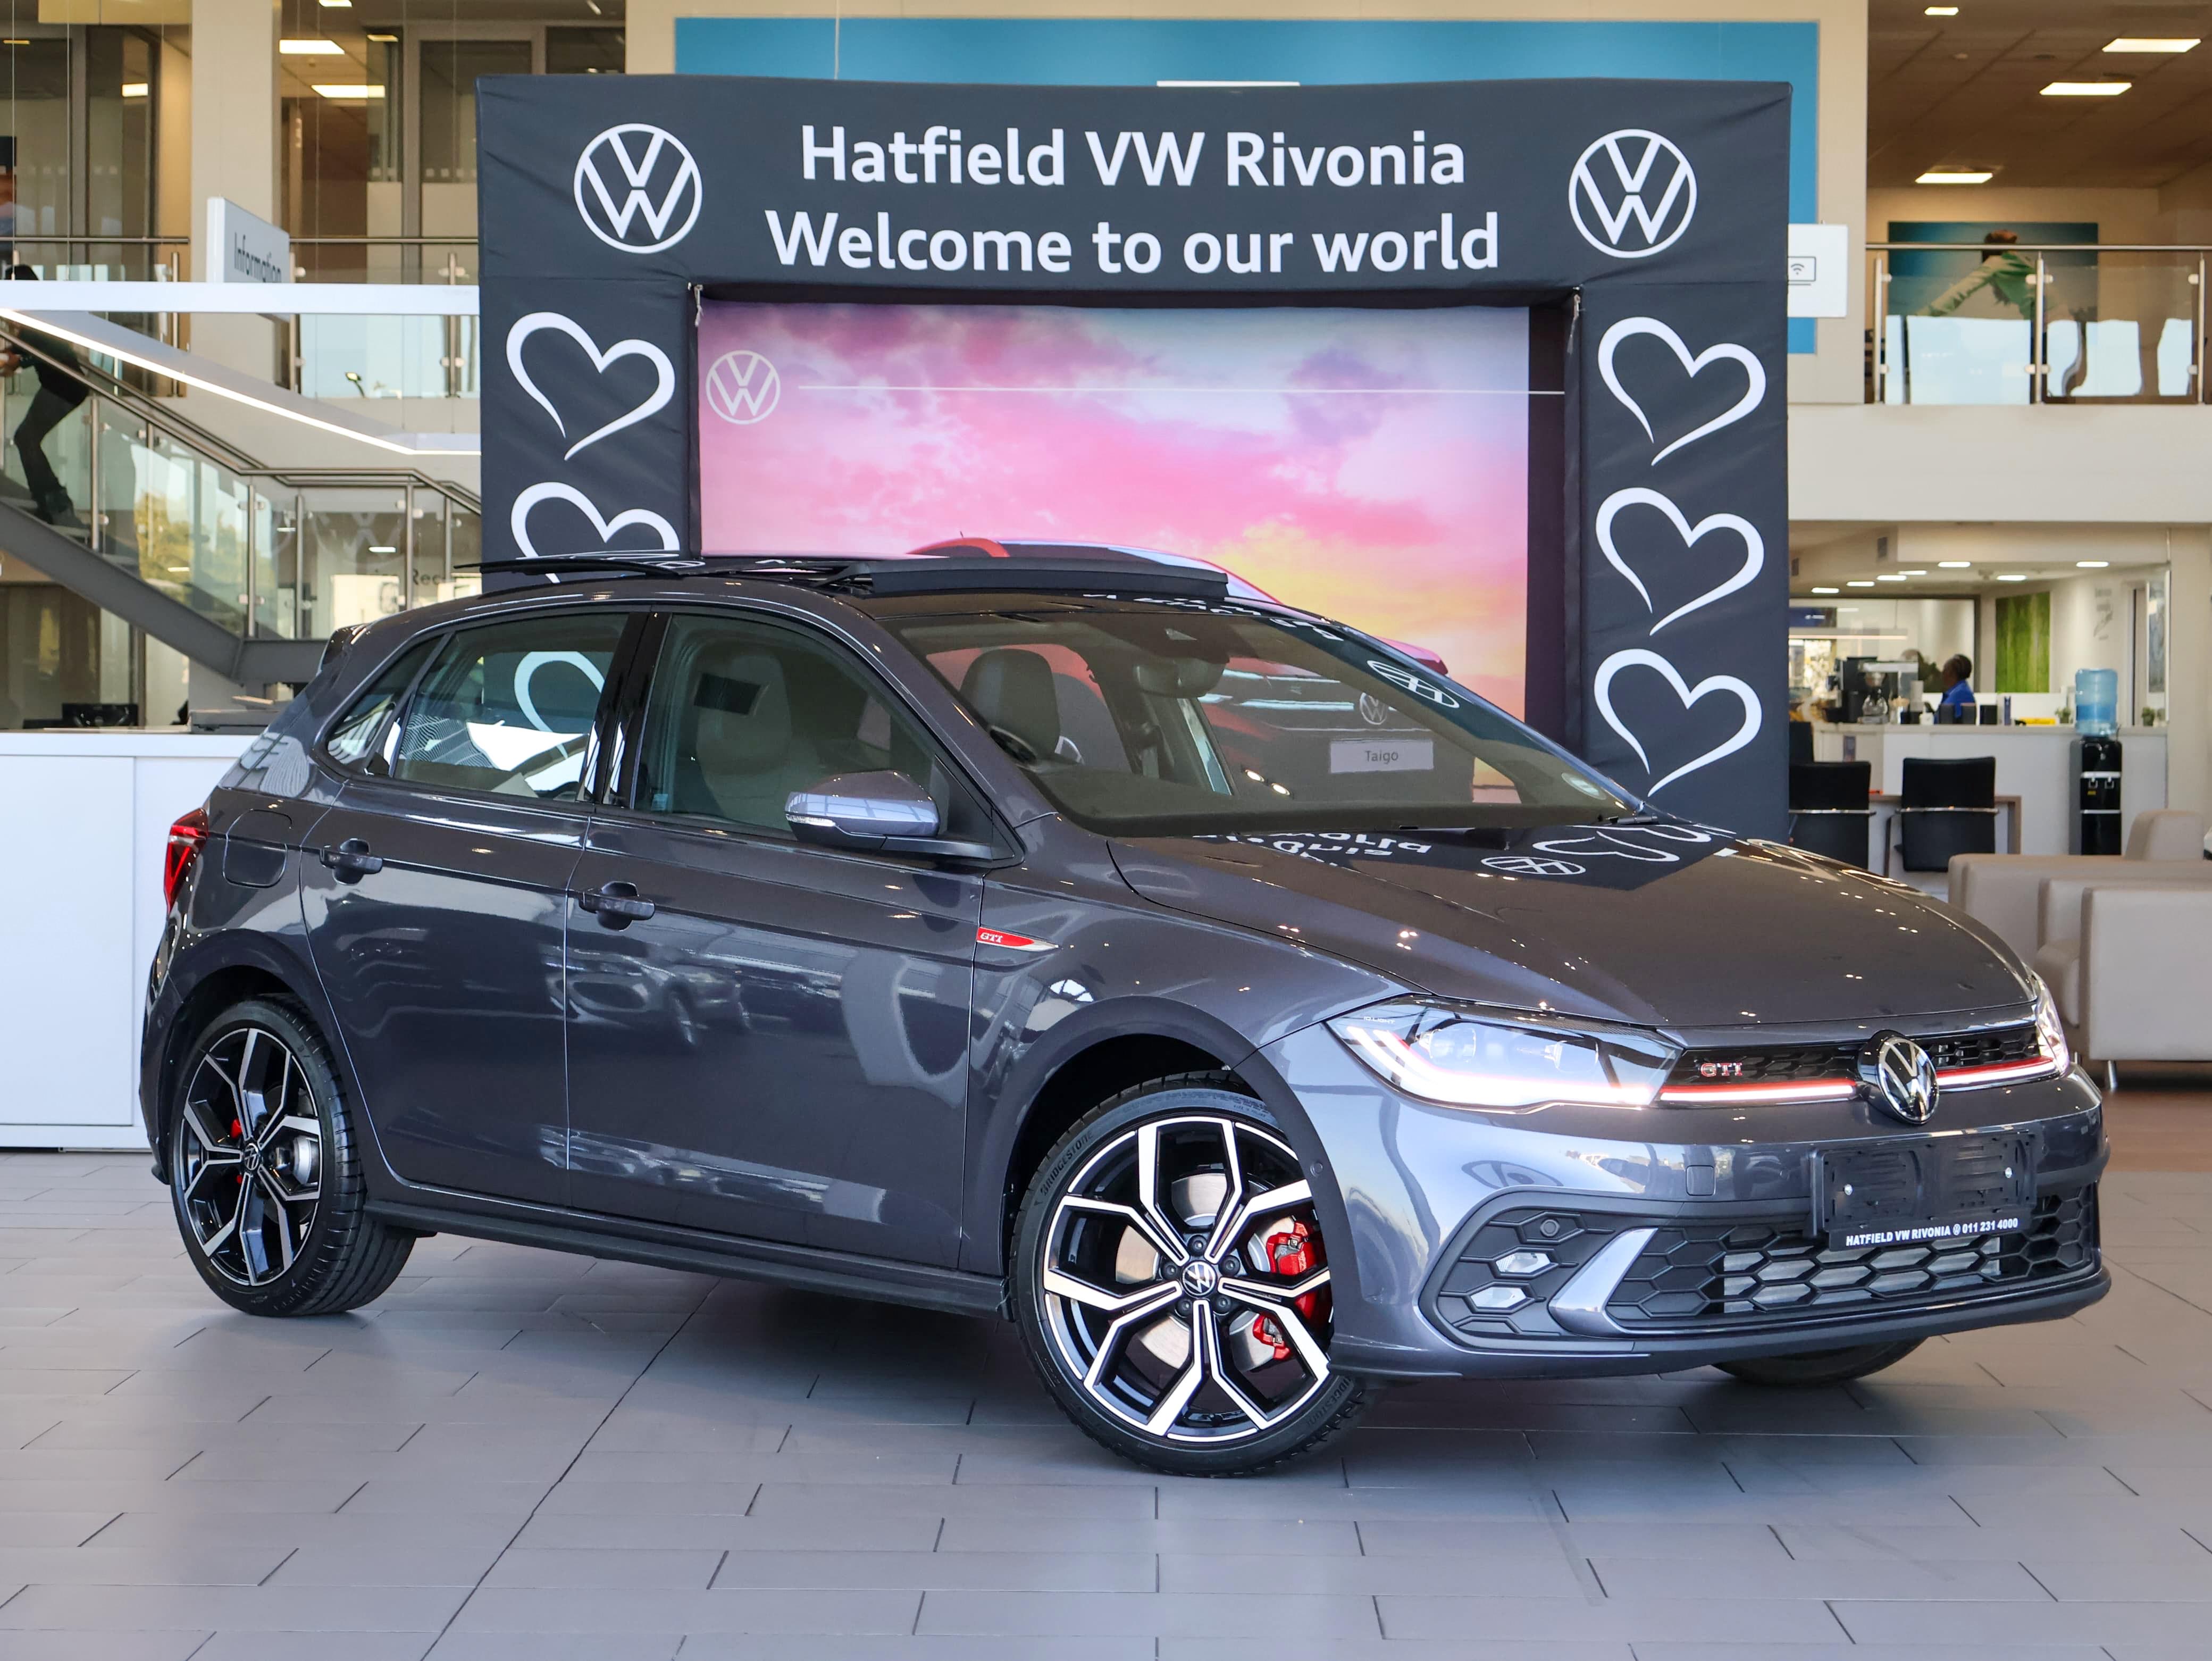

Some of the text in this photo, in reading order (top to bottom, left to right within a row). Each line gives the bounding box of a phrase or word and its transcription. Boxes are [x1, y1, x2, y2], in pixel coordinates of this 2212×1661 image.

[802, 124, 1465, 186] Hatfield VW Rivonia
[764, 210, 1498, 273] Welcome to our world
[234, 231, 281, 282] Information
[1365, 750, 1399, 764] Taigo
[980, 932, 1003, 943] GTI
[1700, 1063, 1743, 1077] GTI
[1846, 1232, 1892, 1246] HATFIELD
[1895, 1230, 1911, 1241] VW
[1912, 1227, 1950, 1239] RIVONIA
[1962, 1222, 1978, 1233] 011
[1980, 1220, 1996, 1232] 231
[1997, 1217, 2018, 1229] 4000
